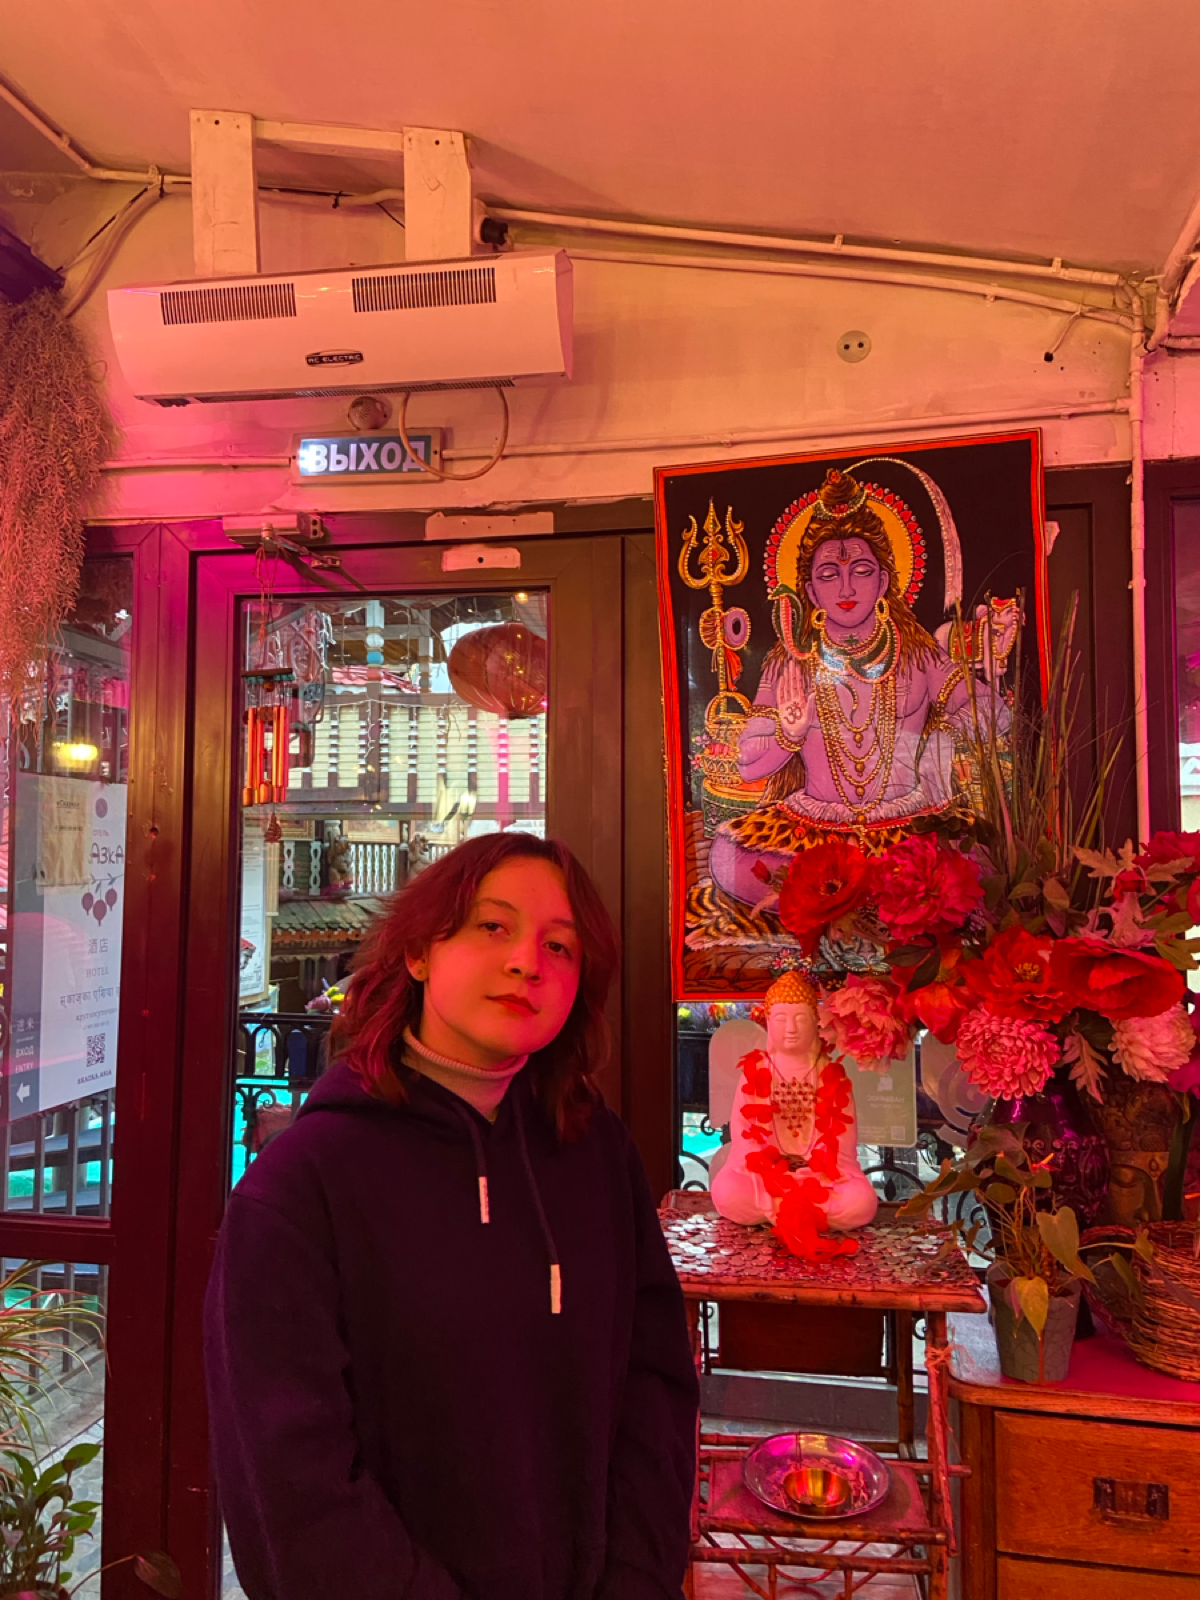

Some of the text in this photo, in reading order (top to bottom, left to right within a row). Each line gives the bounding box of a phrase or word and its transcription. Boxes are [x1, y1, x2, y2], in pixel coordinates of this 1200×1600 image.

[322, 354, 361, 363] ELECTRIC
[307, 442, 426, 472] ВЫХОД
[86, 967, 109, 978] HOTEL
[16, 1045, 33, 1058] ВХОД
[15, 1062, 33, 1074] ENTRY
